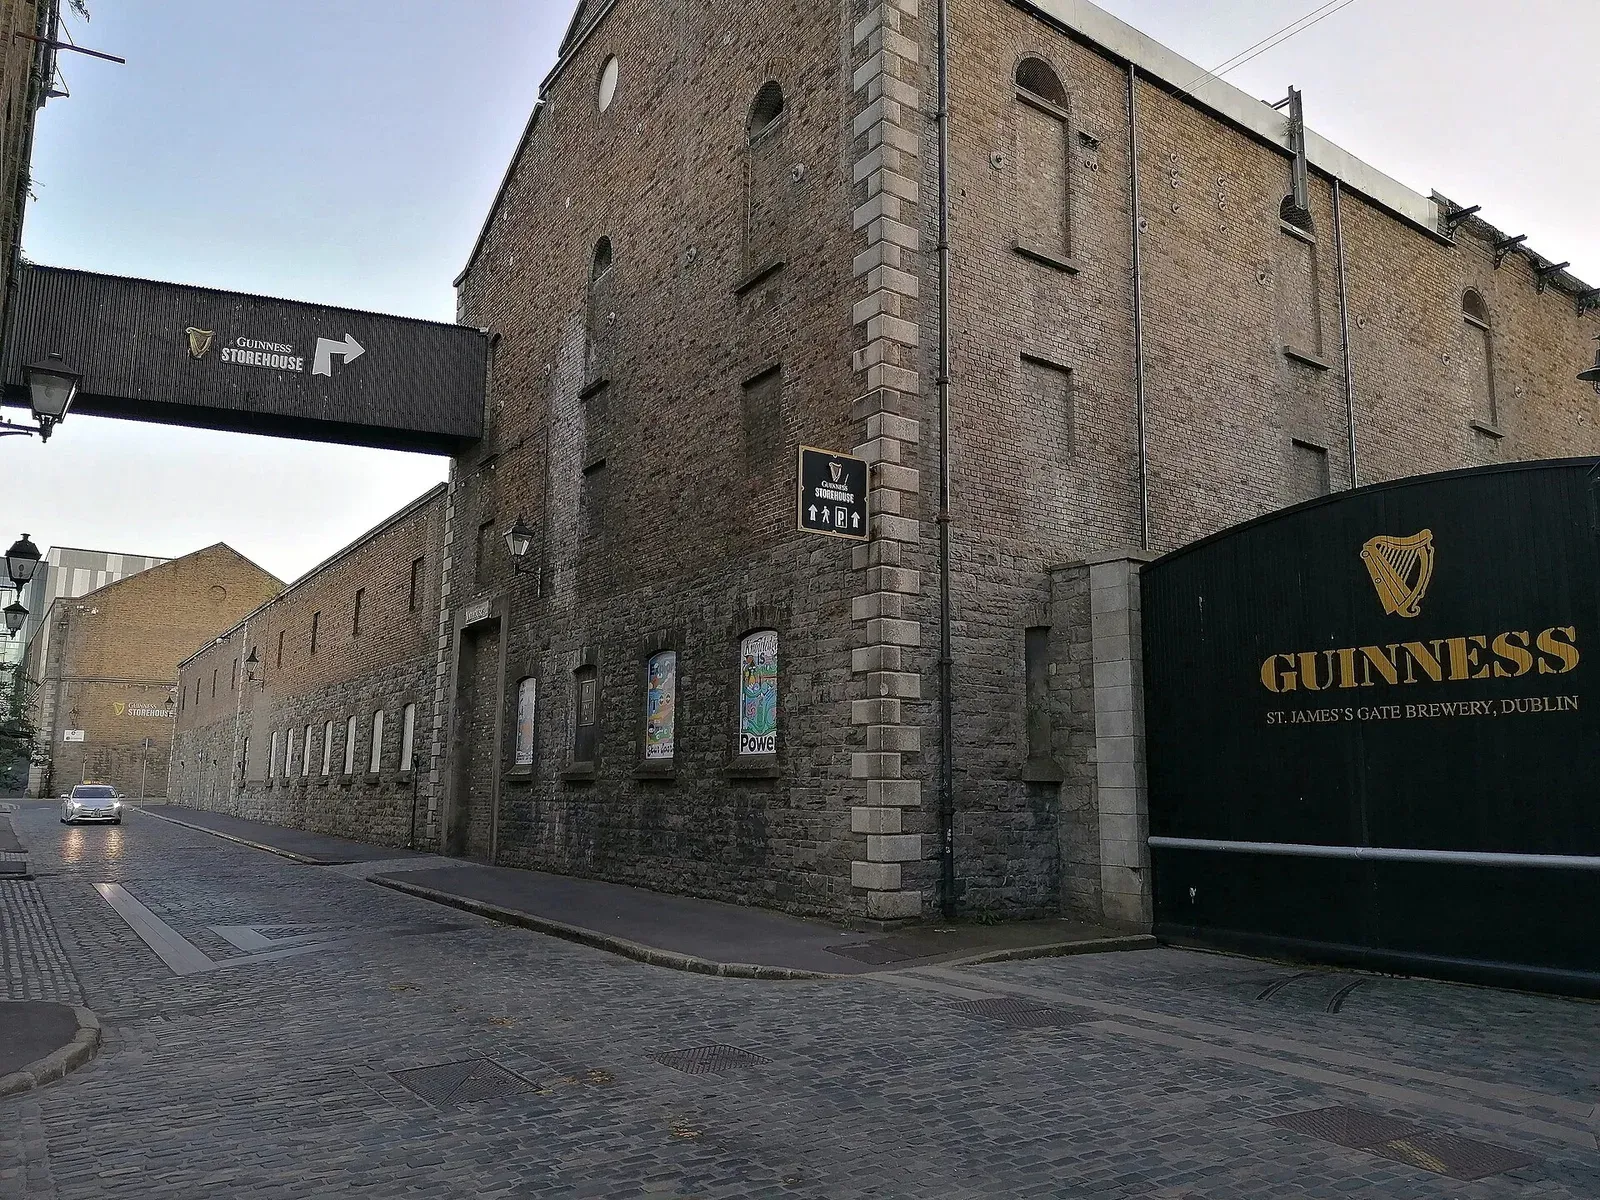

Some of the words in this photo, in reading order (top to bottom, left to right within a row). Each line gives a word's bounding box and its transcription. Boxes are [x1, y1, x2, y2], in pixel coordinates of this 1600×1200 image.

[236, 336, 292, 353] GUINNESS
[221, 347, 303, 371] STOREHOUSE
[821, 480, 848, 491] GUINNESS
[814, 487, 855, 503] STOREHOUSE
[1260, 626, 1580, 693] GUINNESS
[127, 708, 173, 717] STOREHOUSE
[1266, 710, 1287, 725] ST.
[1290, 706, 1353, 724] JAMES'S
[1357, 705, 1401, 721] GATE
[1406, 700, 1497, 719] BREWERY,
[1501, 695, 1580, 714] DUBLIN
